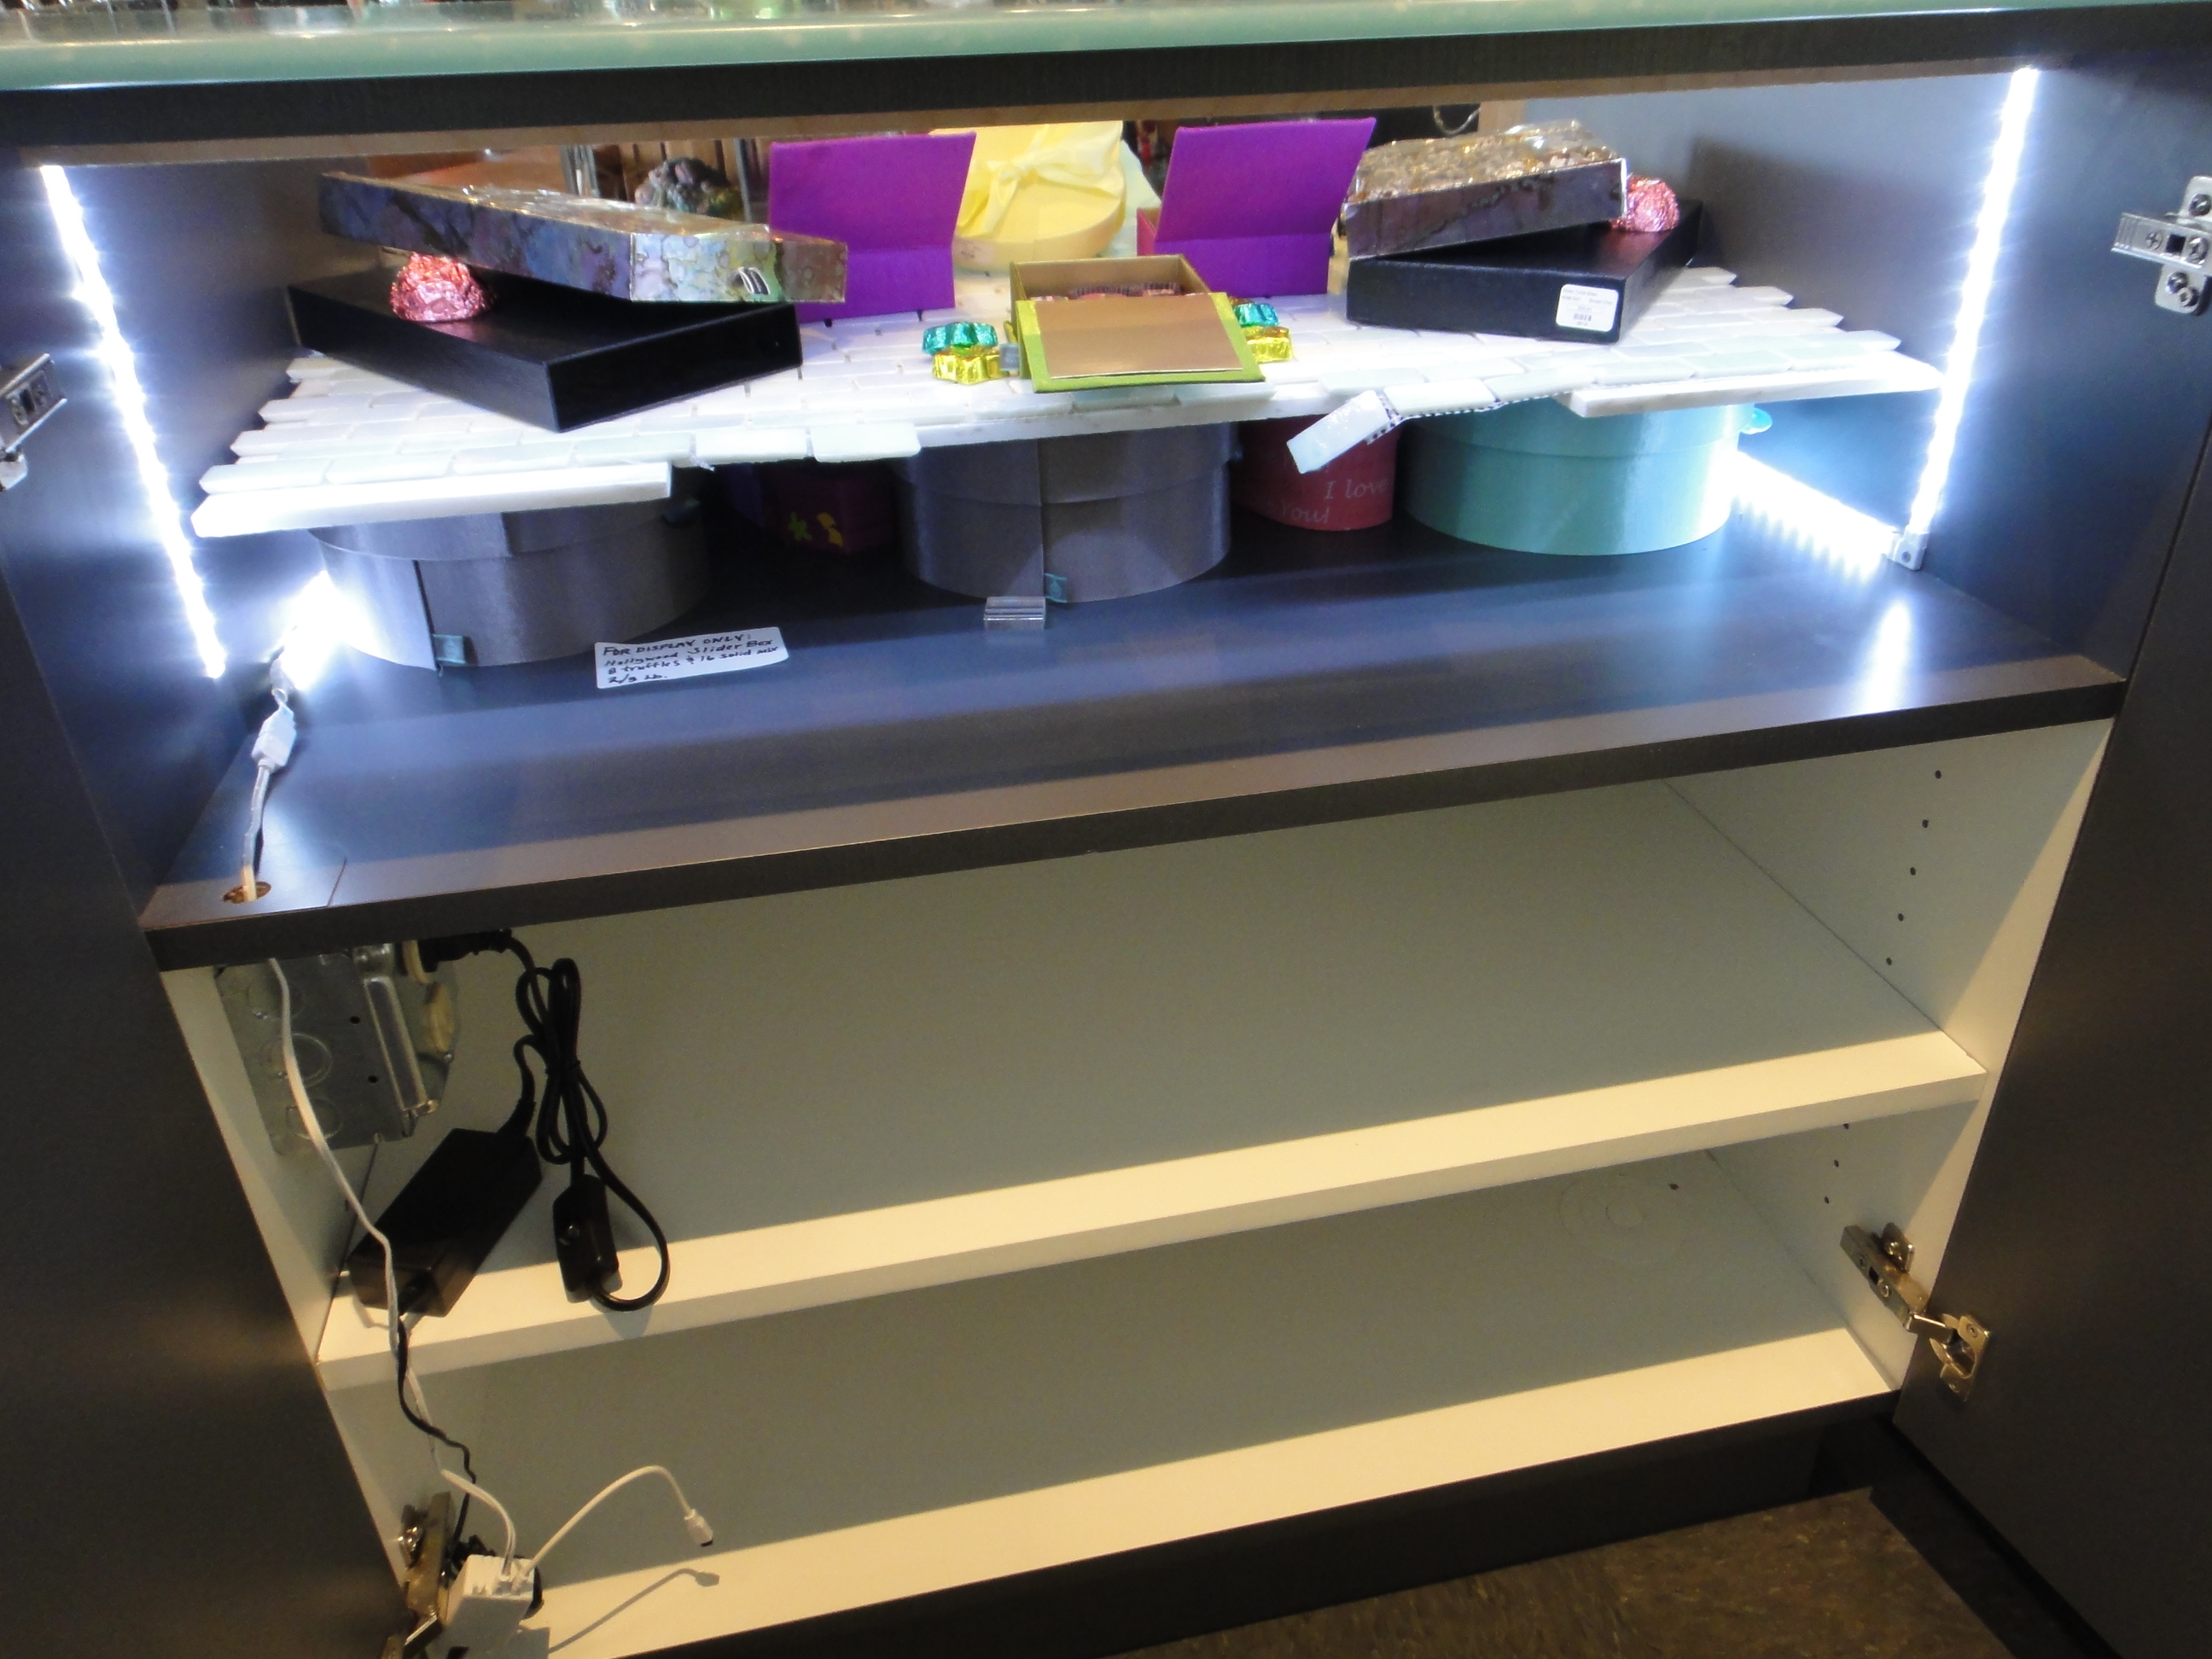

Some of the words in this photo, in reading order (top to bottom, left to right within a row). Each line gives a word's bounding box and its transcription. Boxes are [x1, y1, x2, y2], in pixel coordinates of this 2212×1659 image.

[603, 646, 632, 655] FOR
[636, 639, 696, 653] DISPLAY
[605, 652, 678, 667] Hollywood
[687, 643, 742, 654] Slider
[621, 660, 681, 672] truffles
